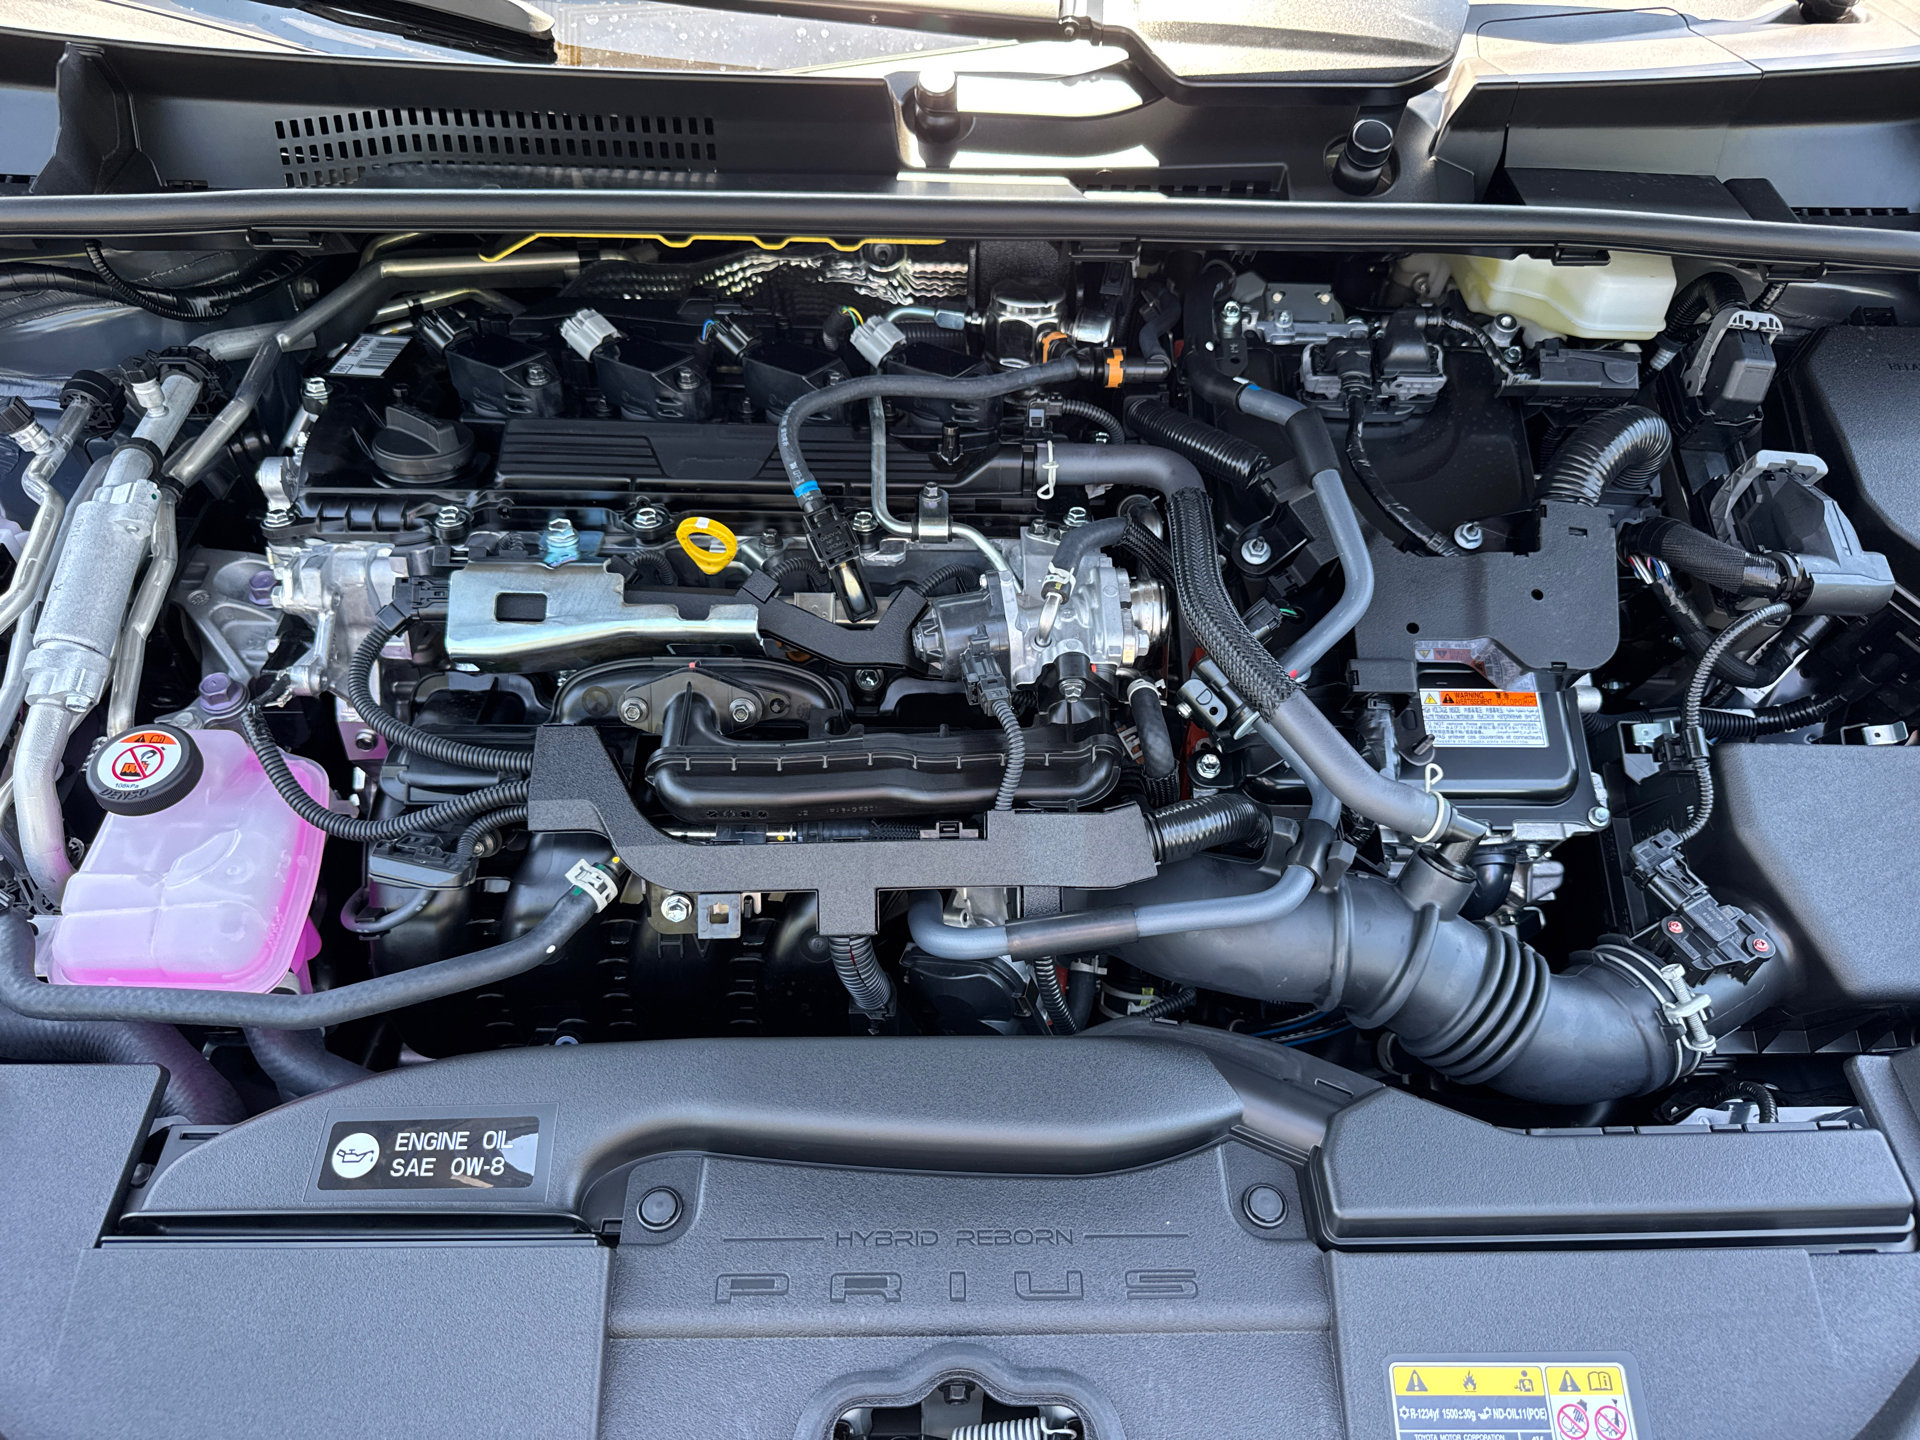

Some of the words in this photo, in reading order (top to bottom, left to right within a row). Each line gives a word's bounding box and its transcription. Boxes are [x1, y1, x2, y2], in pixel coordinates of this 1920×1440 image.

[98, 787, 150, 801] DENSO
[395, 1131, 470, 1151] ENGINE
[482, 1129, 514, 1149] OIL
[390, 1157, 437, 1177] SAE
[450, 1156, 505, 1176] 0W-8
[835, 1230, 939, 1247] HYBRID
[955, 1229, 1073, 1246] REBORN
[714, 1269, 1199, 1302] PRIUS
[1410, 1407, 1439, 1421] R-1234yf
[1442, 1407, 1476, 1422] 1500±30g
[1493, 1407, 1547, 1420] ND-OIL11(POE)
